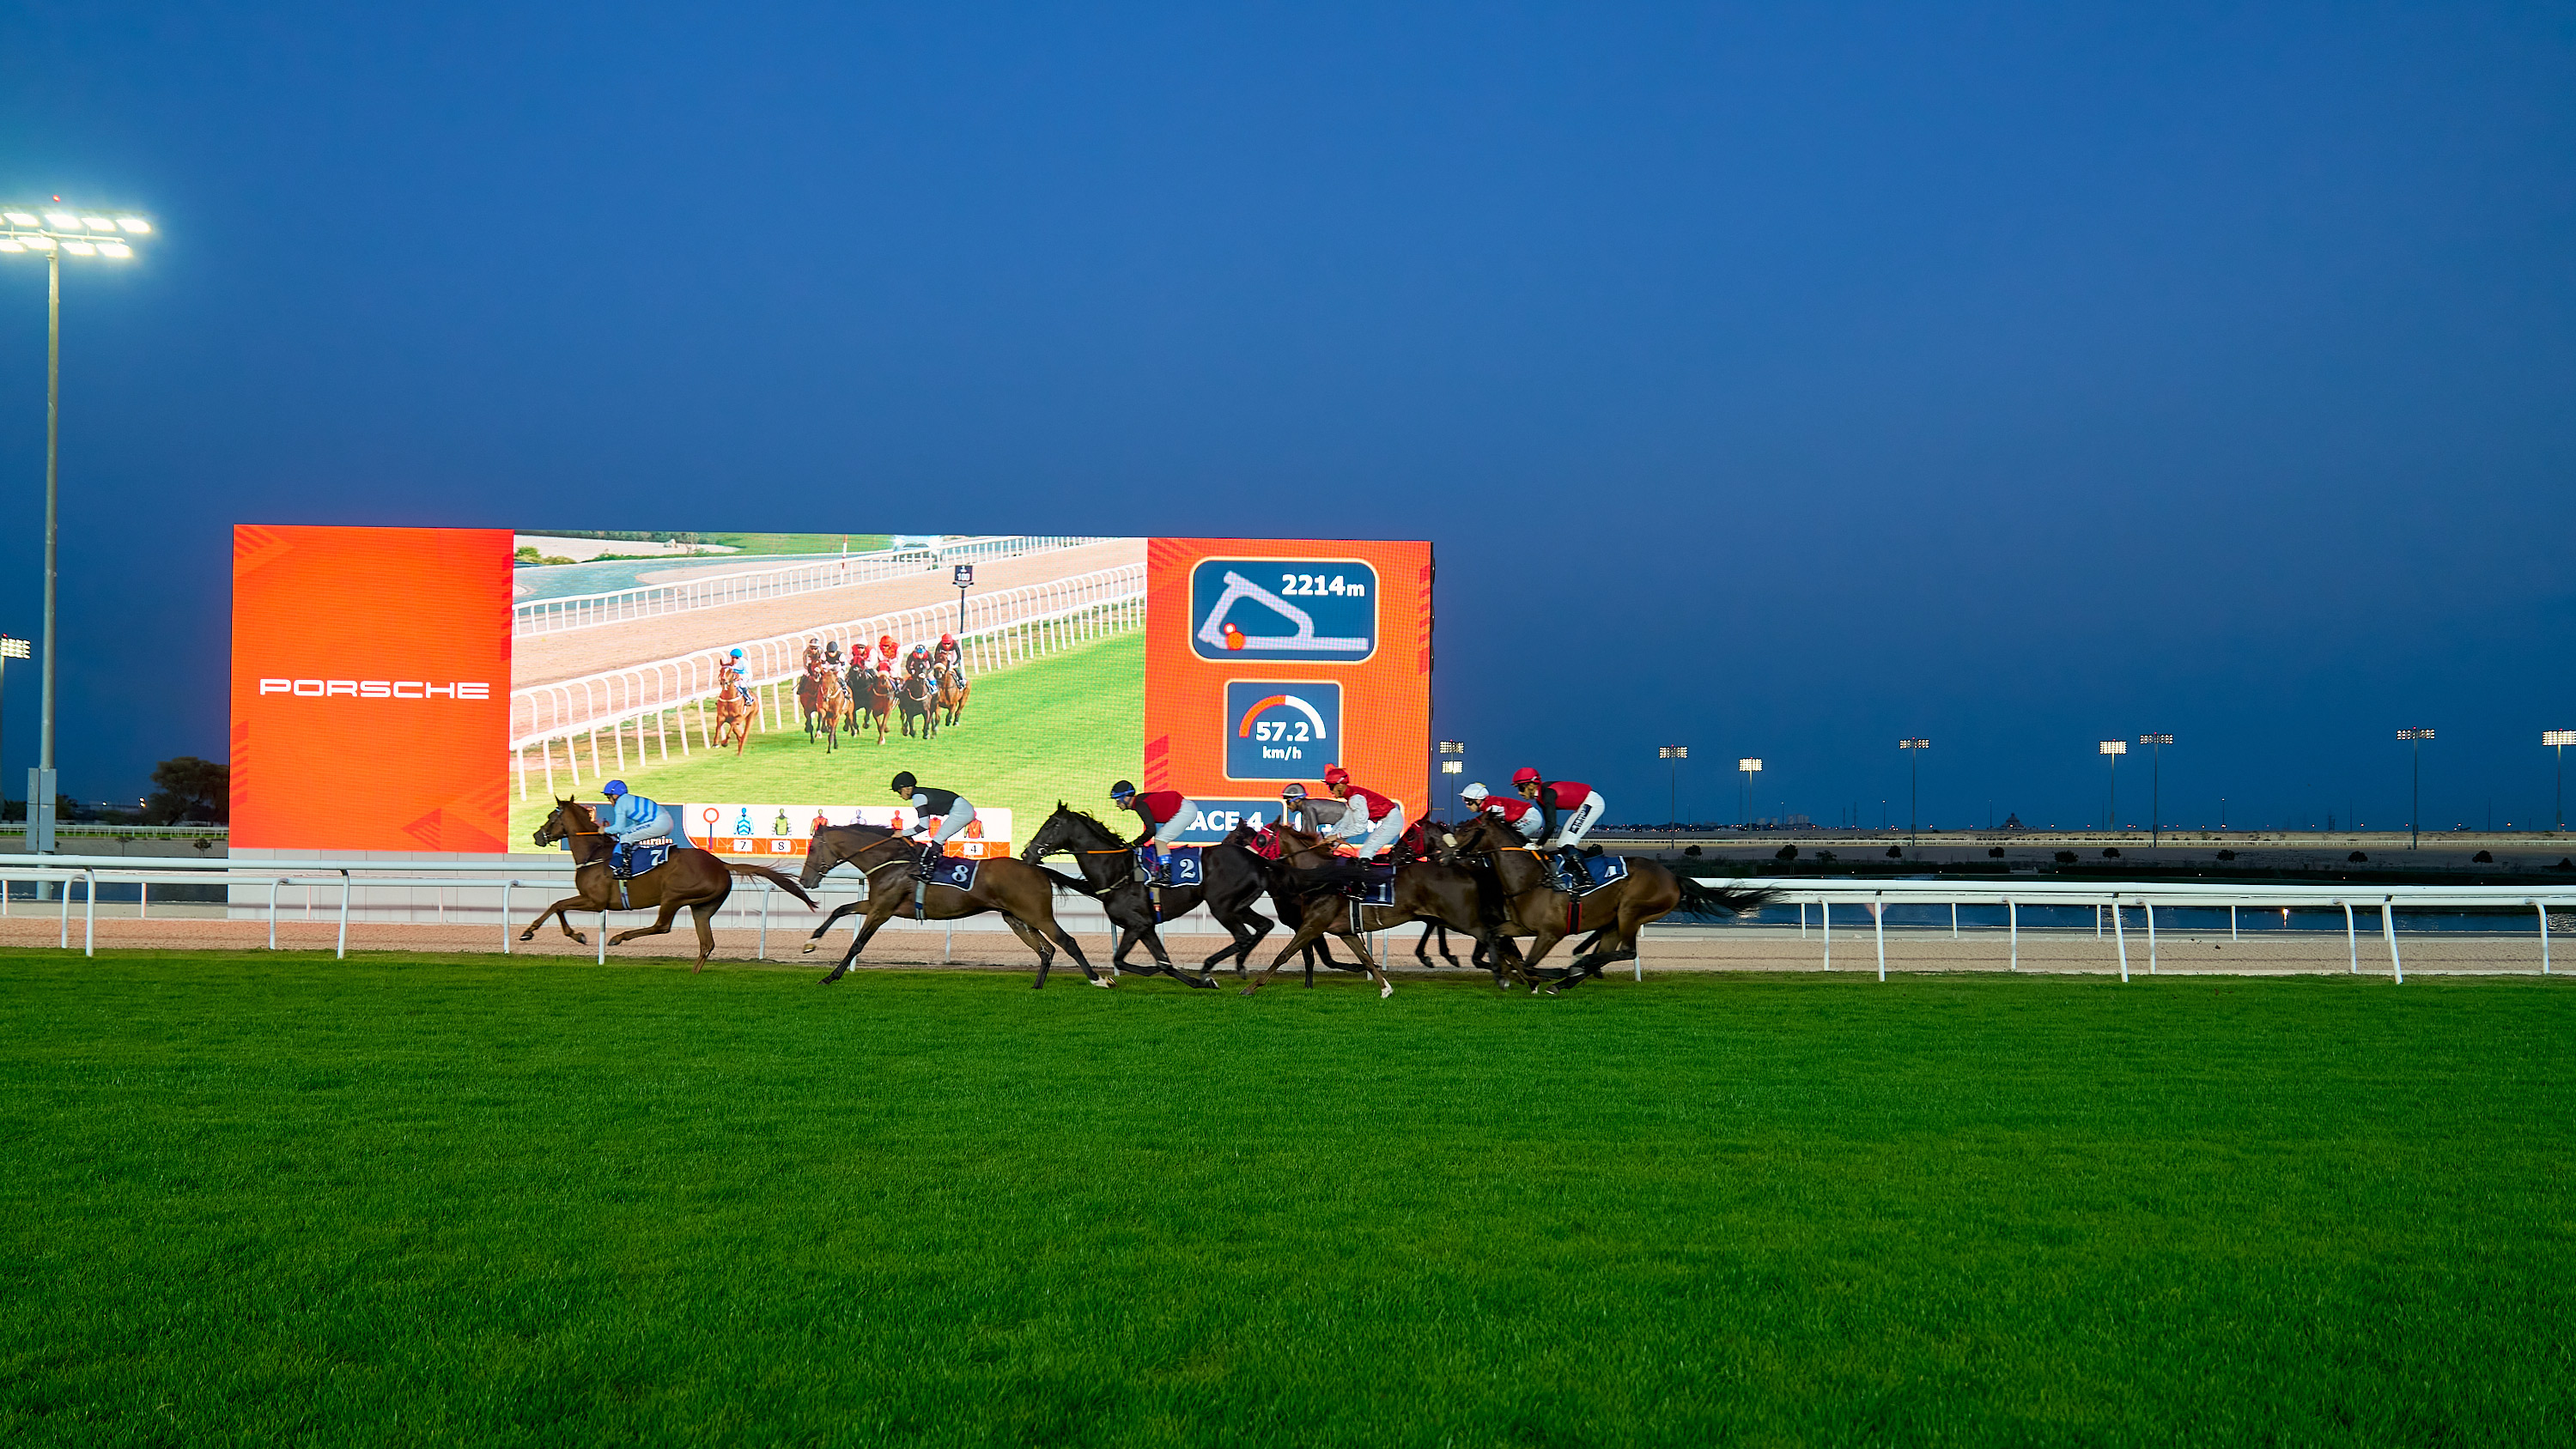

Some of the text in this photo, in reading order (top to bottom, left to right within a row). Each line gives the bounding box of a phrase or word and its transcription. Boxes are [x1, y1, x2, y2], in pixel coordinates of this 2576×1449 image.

[1281, 573, 1365, 597] 2214m
[259, 678, 489, 700] PORSCHE
[1255, 721, 1309, 742] 57.2
[1262, 745, 1302, 761] km/h
[1185, 809, 1263, 832] ACE 4
[740, 841, 977, 853] 7 8 4
[650, 849, 663, 866] 7
[951, 864, 969, 882] 8
[1179, 858, 1196, 879] 2
[1377, 882, 1387, 902] 1
